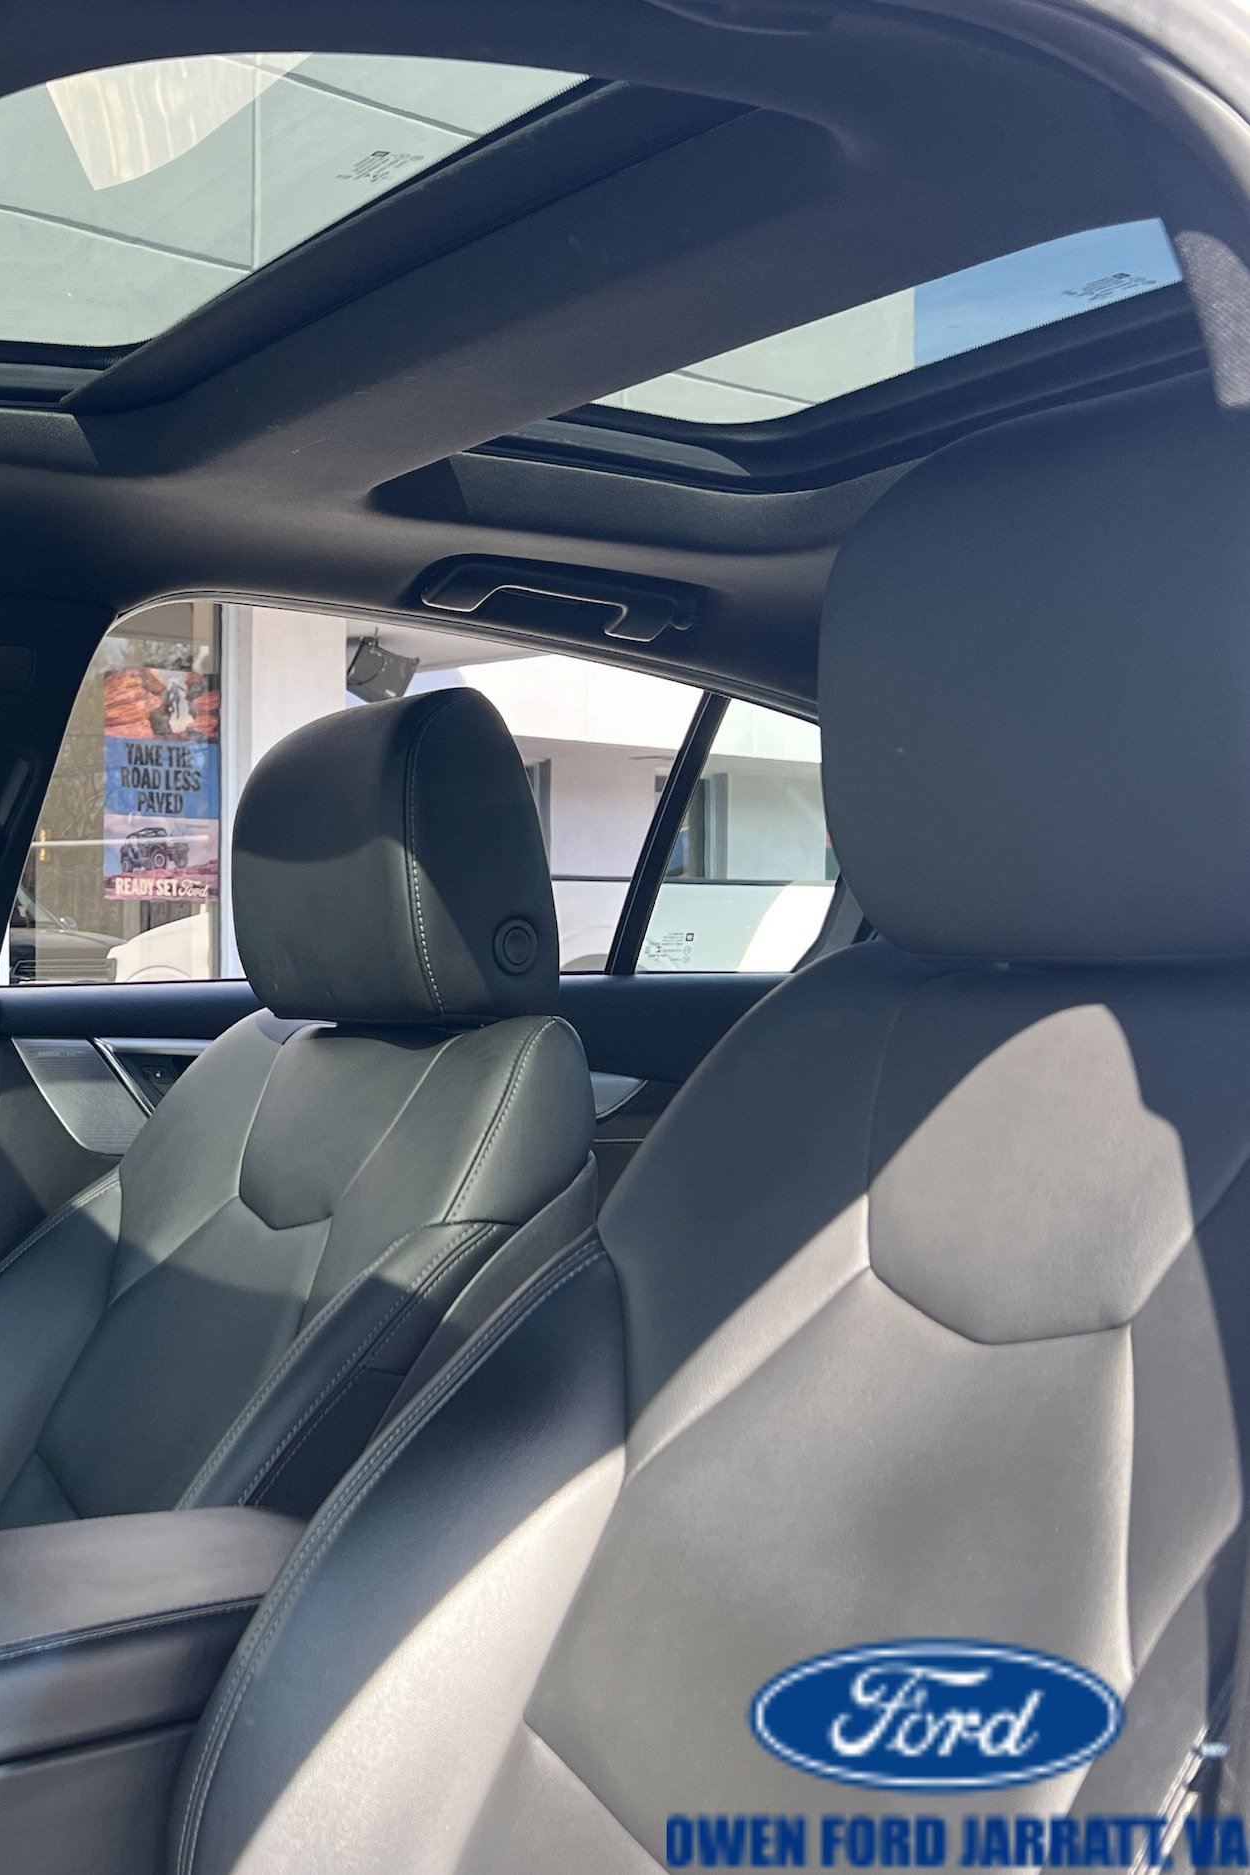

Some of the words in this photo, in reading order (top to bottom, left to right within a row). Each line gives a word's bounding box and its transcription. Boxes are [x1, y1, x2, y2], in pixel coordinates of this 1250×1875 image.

[125, 743, 163, 767] TAKE
[121, 766, 161, 790] ROAD
[165, 769, 201, 792] LESS
[137, 791, 184, 814] PAVED
[115, 877, 155, 895] READY
[156, 879, 178, 896] SET
[178, 879, 210, 897] Ford
